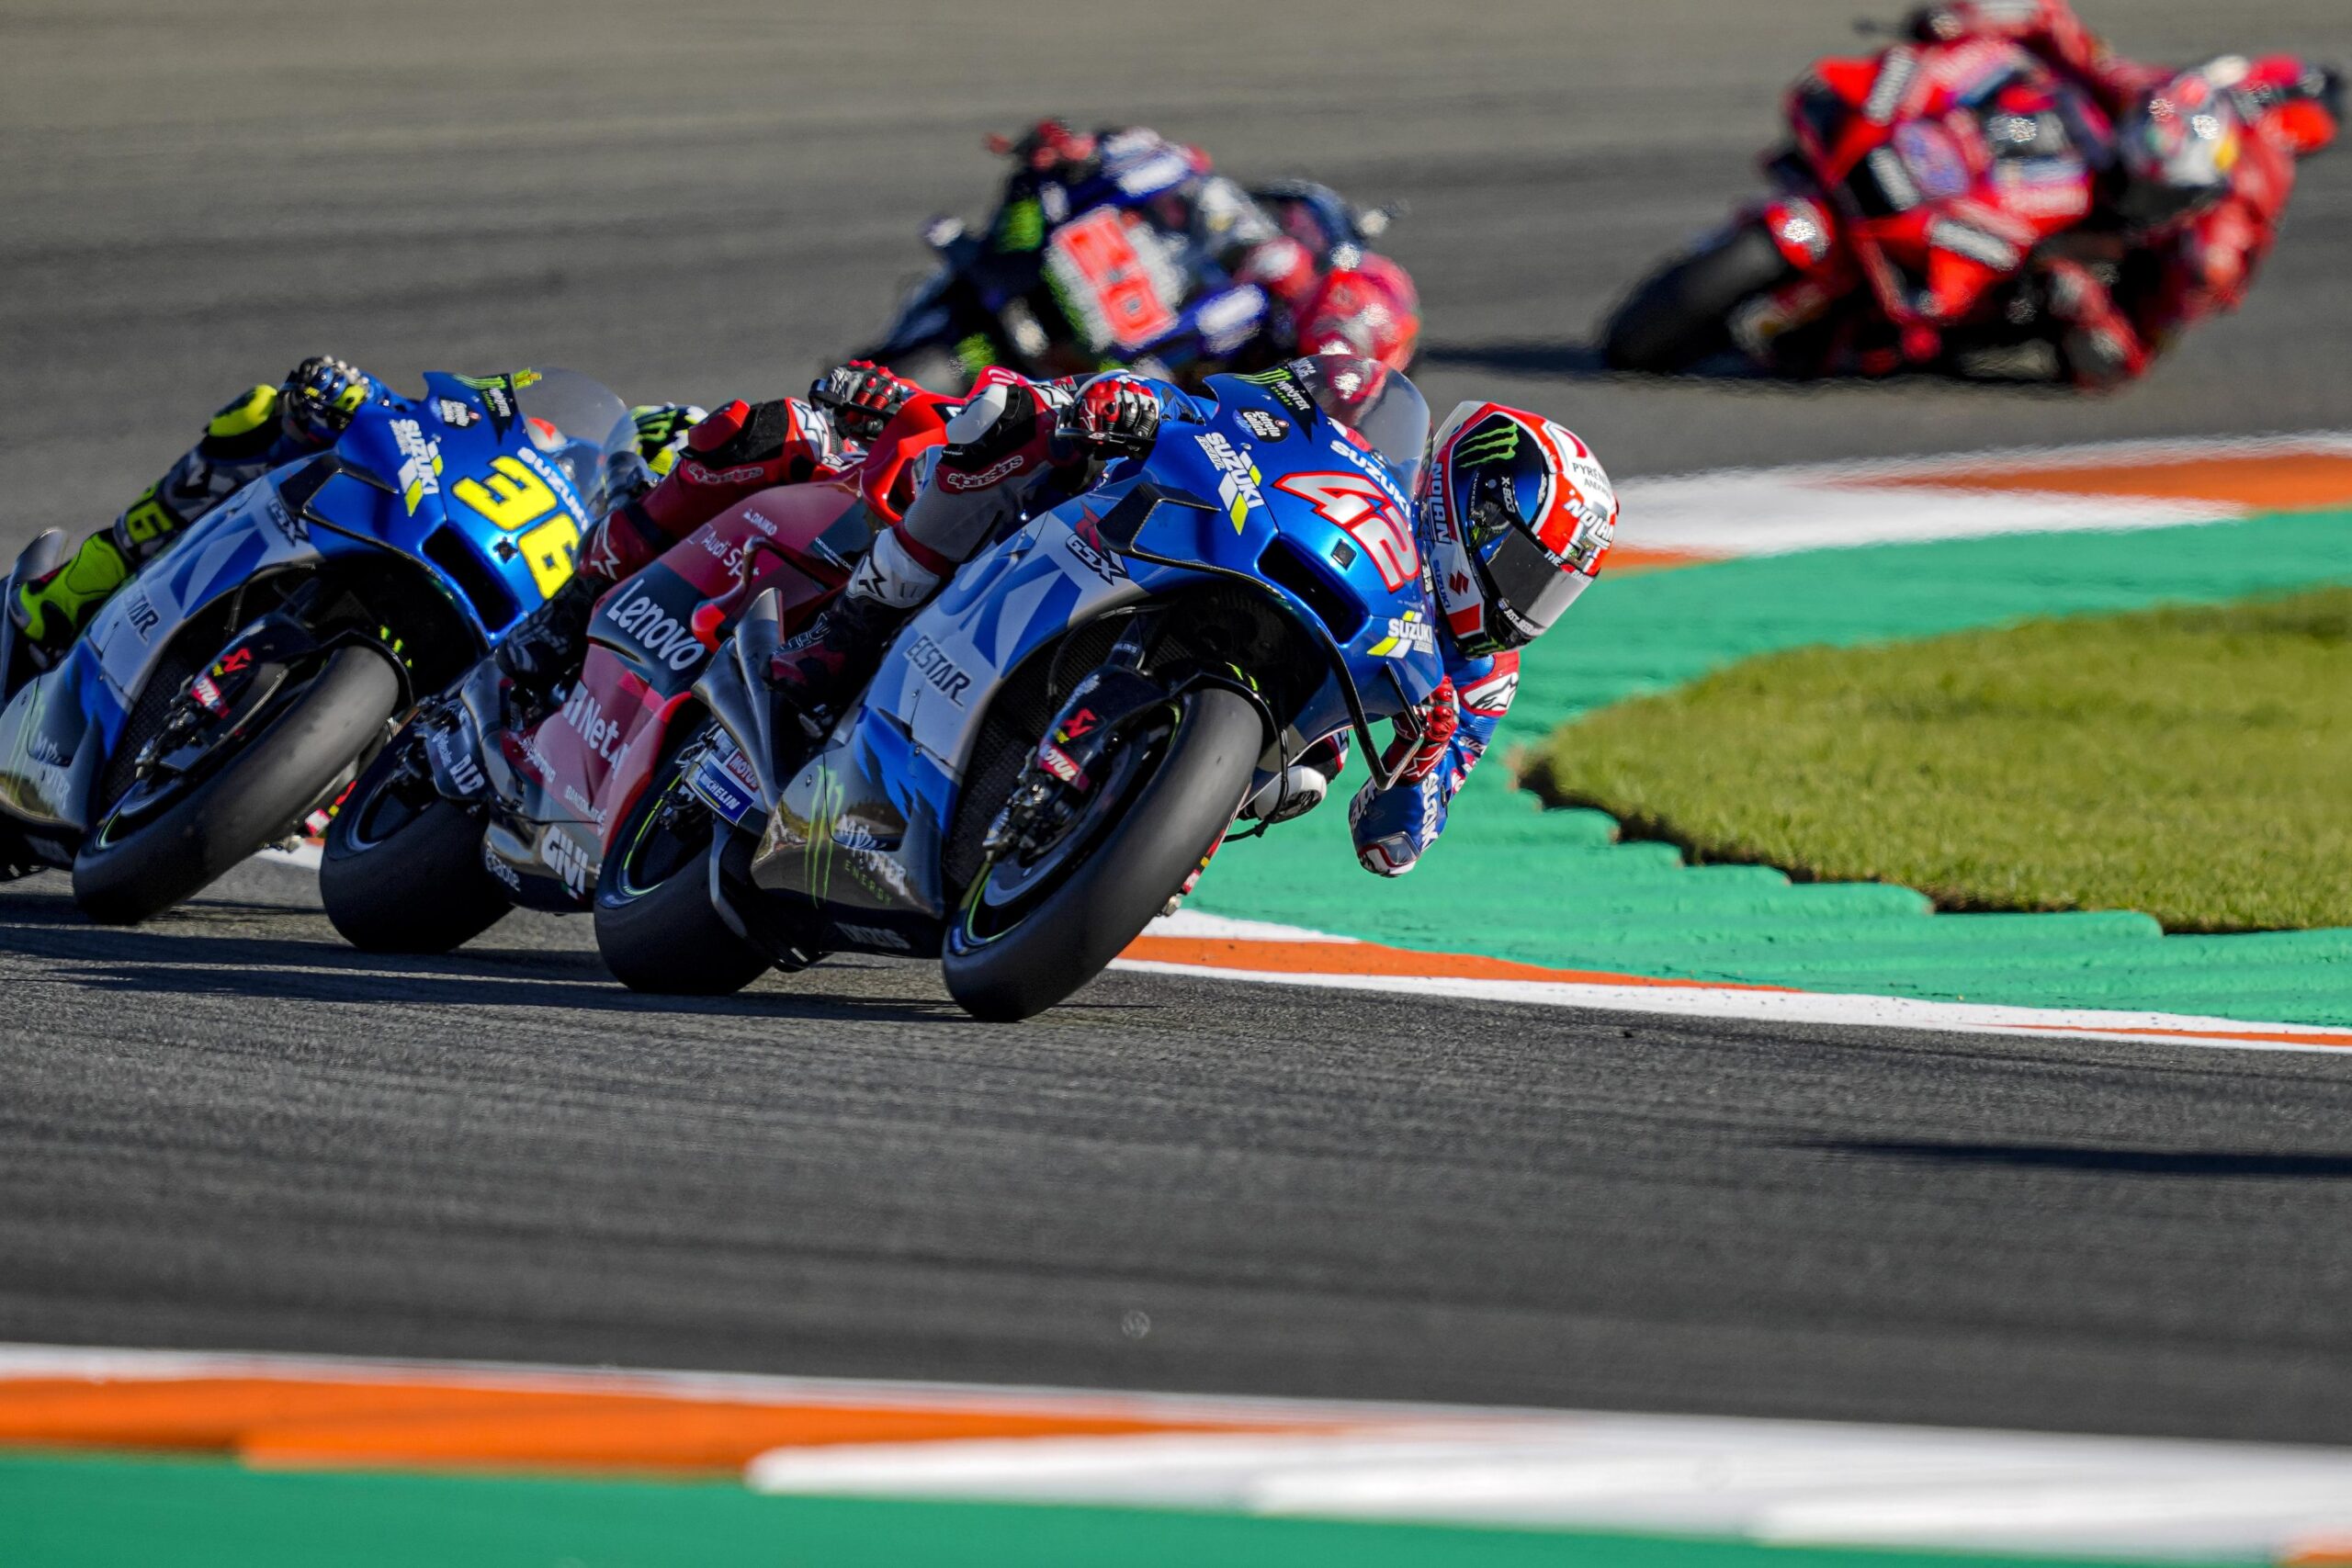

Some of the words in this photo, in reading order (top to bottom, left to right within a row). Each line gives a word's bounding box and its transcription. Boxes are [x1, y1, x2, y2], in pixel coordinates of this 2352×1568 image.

[1276, 379, 1311, 411] MONSTER
[1242, 412, 1268, 436] Galicia
[1254, 411, 1281, 437] Estrella
[397, 418, 440, 495] SUZUKI
[947, 455, 1024, 491] alpinestars
[1205, 432, 1264, 509] SUZUKI
[1329, 439, 1411, 519] SUZUKI
[450, 455, 582, 601] 36
[1430, 461, 1453, 545] NOLAN
[1562, 498, 1614, 549] NOLAN
[702, 531, 730, 558] Audi
[1271, 470, 1421, 594] 42
[1066, 533, 1128, 586] GSX
[1544, 549, 1564, 567] THE
[1433, 559, 1452, 609] SUZUKI
[606, 579, 706, 671] Lenovo
[1387, 619, 1434, 642] SUZUKI
[906, 634, 972, 707] ECSTAR
[702, 773, 741, 810] CHELIN
[541, 825, 589, 896] GIVI
[844, 860, 892, 906] ENERGY
